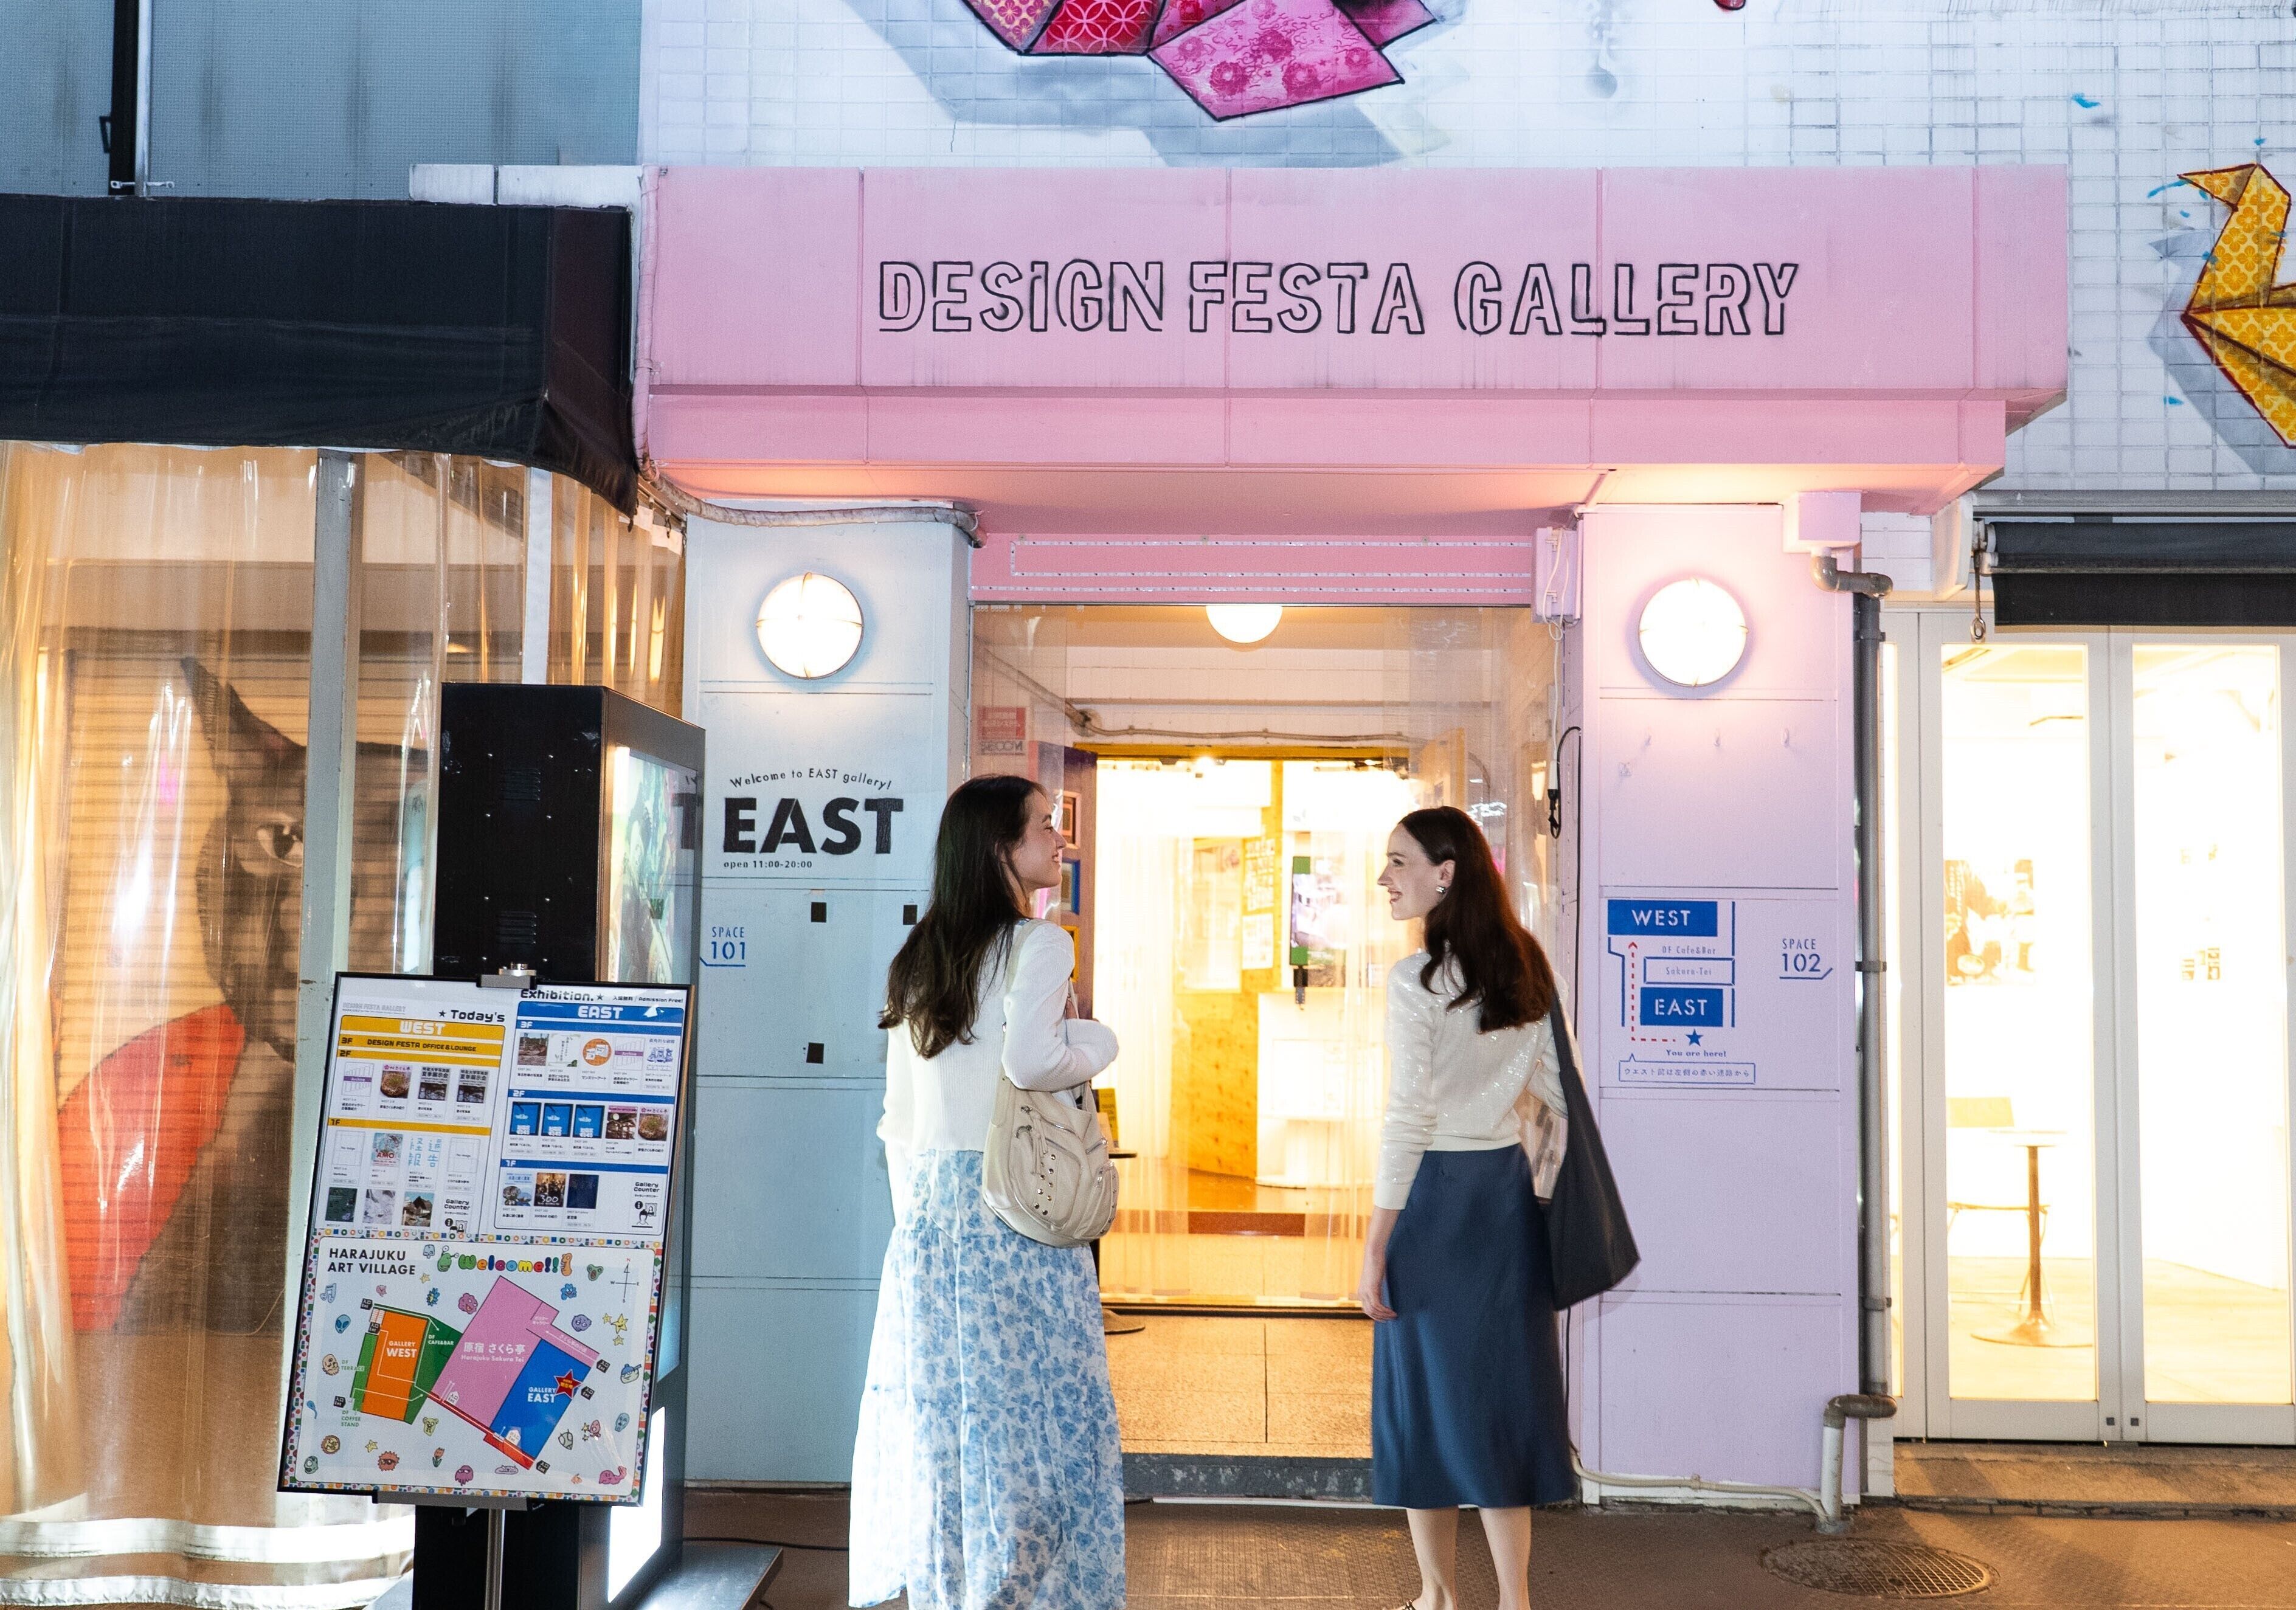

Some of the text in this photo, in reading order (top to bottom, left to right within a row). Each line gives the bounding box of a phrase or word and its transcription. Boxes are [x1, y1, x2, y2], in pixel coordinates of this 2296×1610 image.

[878, 260, 1800, 337] DESIGN FESTA GALLERY
[730, 768, 892, 790] Welcome to EAST gallery!
[723, 797, 904, 855] EAST
[724, 861, 749, 869] open
[1631, 909, 1691, 927] WEST
[711, 927, 745, 938] SPACE
[711, 941, 745, 960] 101
[1782, 938, 1816, 950] SPACE
[1782, 953, 1821, 972] 102
[1666, 967, 1712, 975] Sakura-Tei
[520, 989, 593, 1001] Exhibition.
[577, 1006, 624, 1019] EAST
[1655, 998, 1708, 1016] EAST
[451, 1009, 505, 1023] Today's
[399, 1021, 446, 1035] WEST
[539, 1195, 559, 1203] 300
[329, 1248, 406, 1261] HARAJUKU
[327, 1262, 416, 1276] ART VILLAGE
[386, 1347, 418, 1358] WEST
[463, 1342, 526, 1355] 原宿 さくら亭
[527, 1393, 555, 1403] EAST
